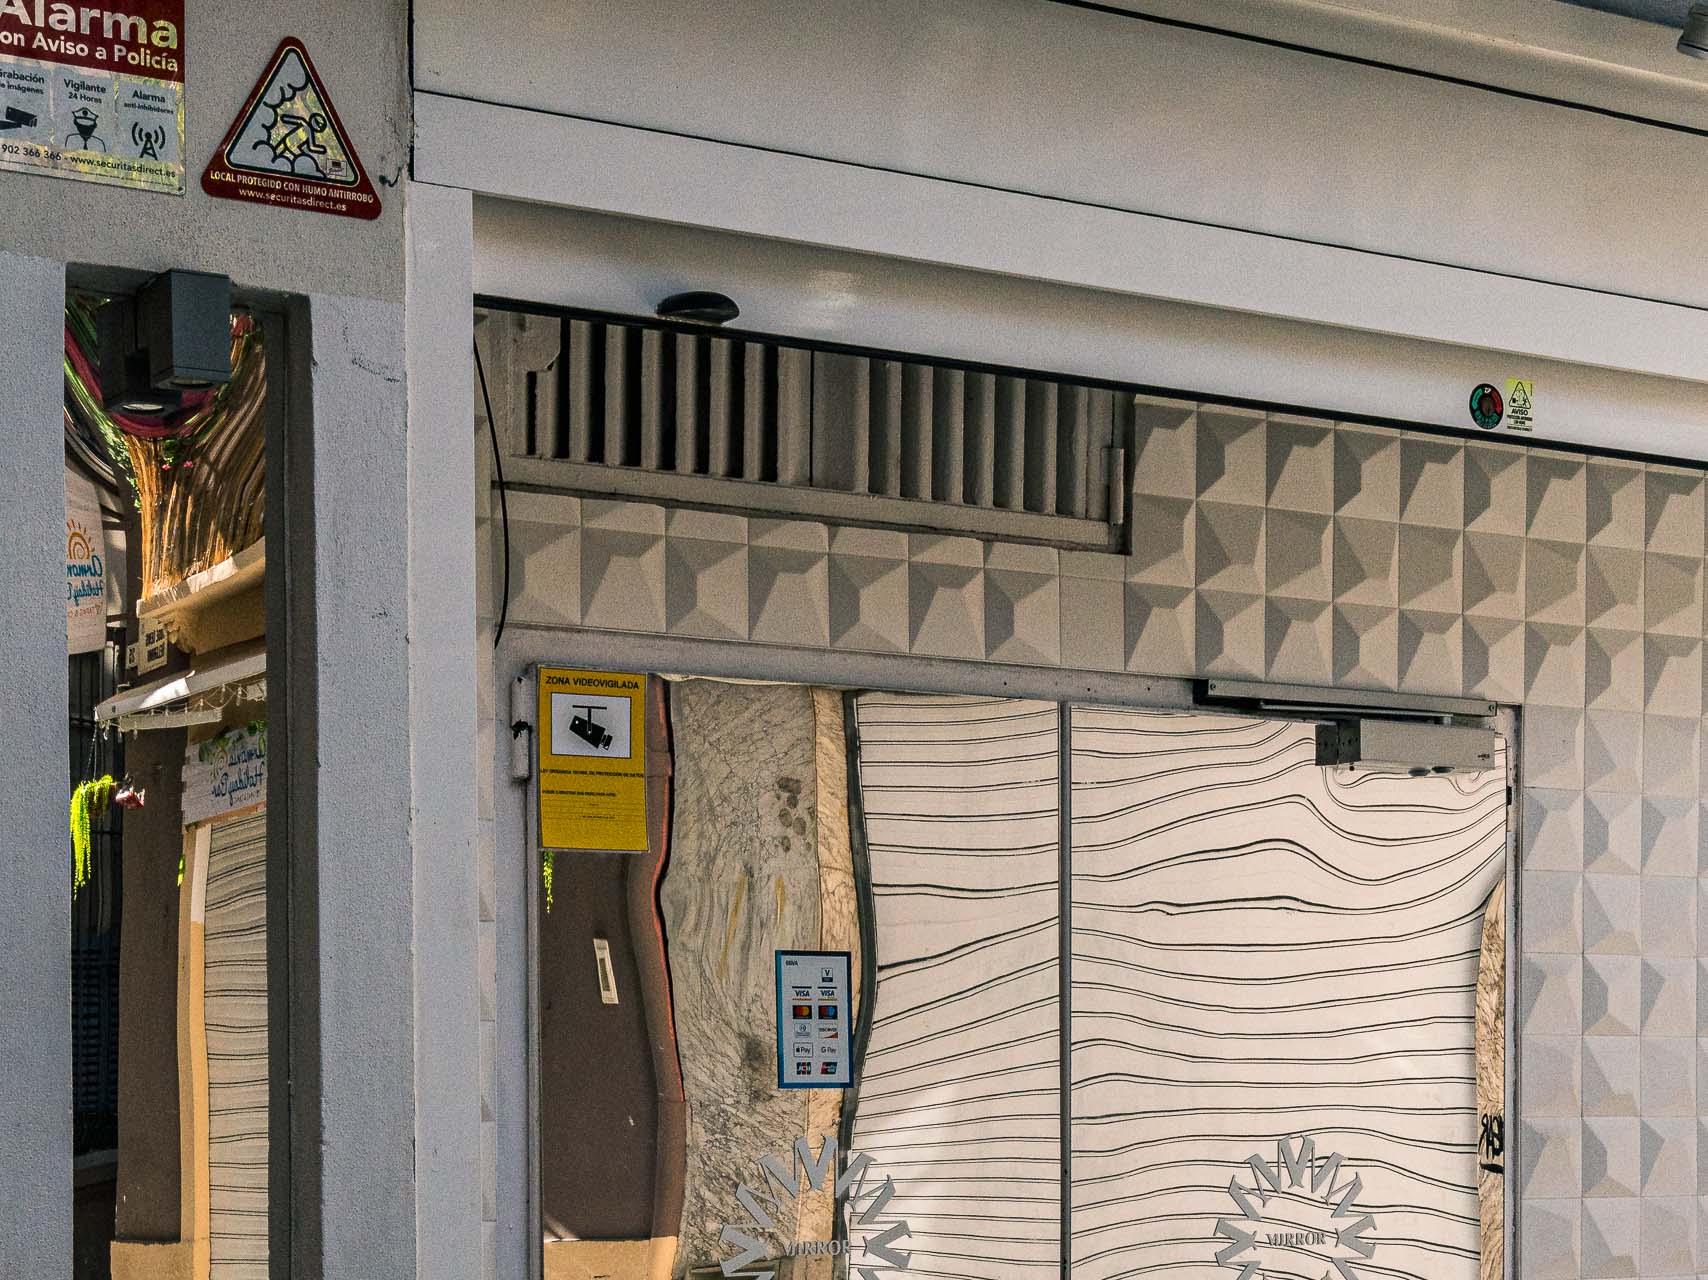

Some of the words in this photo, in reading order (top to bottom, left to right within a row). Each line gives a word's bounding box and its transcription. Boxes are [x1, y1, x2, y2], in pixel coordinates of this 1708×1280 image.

[0, 0, 178, 49] Alarma
[0, 31, 25, 47] on
[32, 32, 89, 56] Aviso
[95, 47, 107, 60] a
[114, 45, 178, 72] Policía
[64, 78, 107, 94] Vigilante
[132, 89, 166, 103] Alarma
[68, 92, 78, 100] 24
[79, 94, 103, 104] Horas
[2, 144, 20, 155] 902
[23, 147, 41, 158] 366
[44, 150, 62, 161] 366
[70, 155, 176, 178] www.securitasdirect.es
[210, 170, 236, 183] LOCAL
[237, 173, 282, 190] PROTEGIDO
[283, 182, 300, 192] CON
[302, 185, 327, 197] HUMO
[328, 190, 374, 204] ANTIRROBO
[239, 188, 347, 212] www.securitasdirect.es
[1511, 408, 1528, 416] AVISO
[545, 676, 570, 686] ZONA
[573, 677, 639, 690] VIDEOVIGILADA
[801, 1046, 811, 1054] Pay
[782, 1239, 850, 1256] MIRROR
[1265, 1232, 1327, 1247] MIRROR
